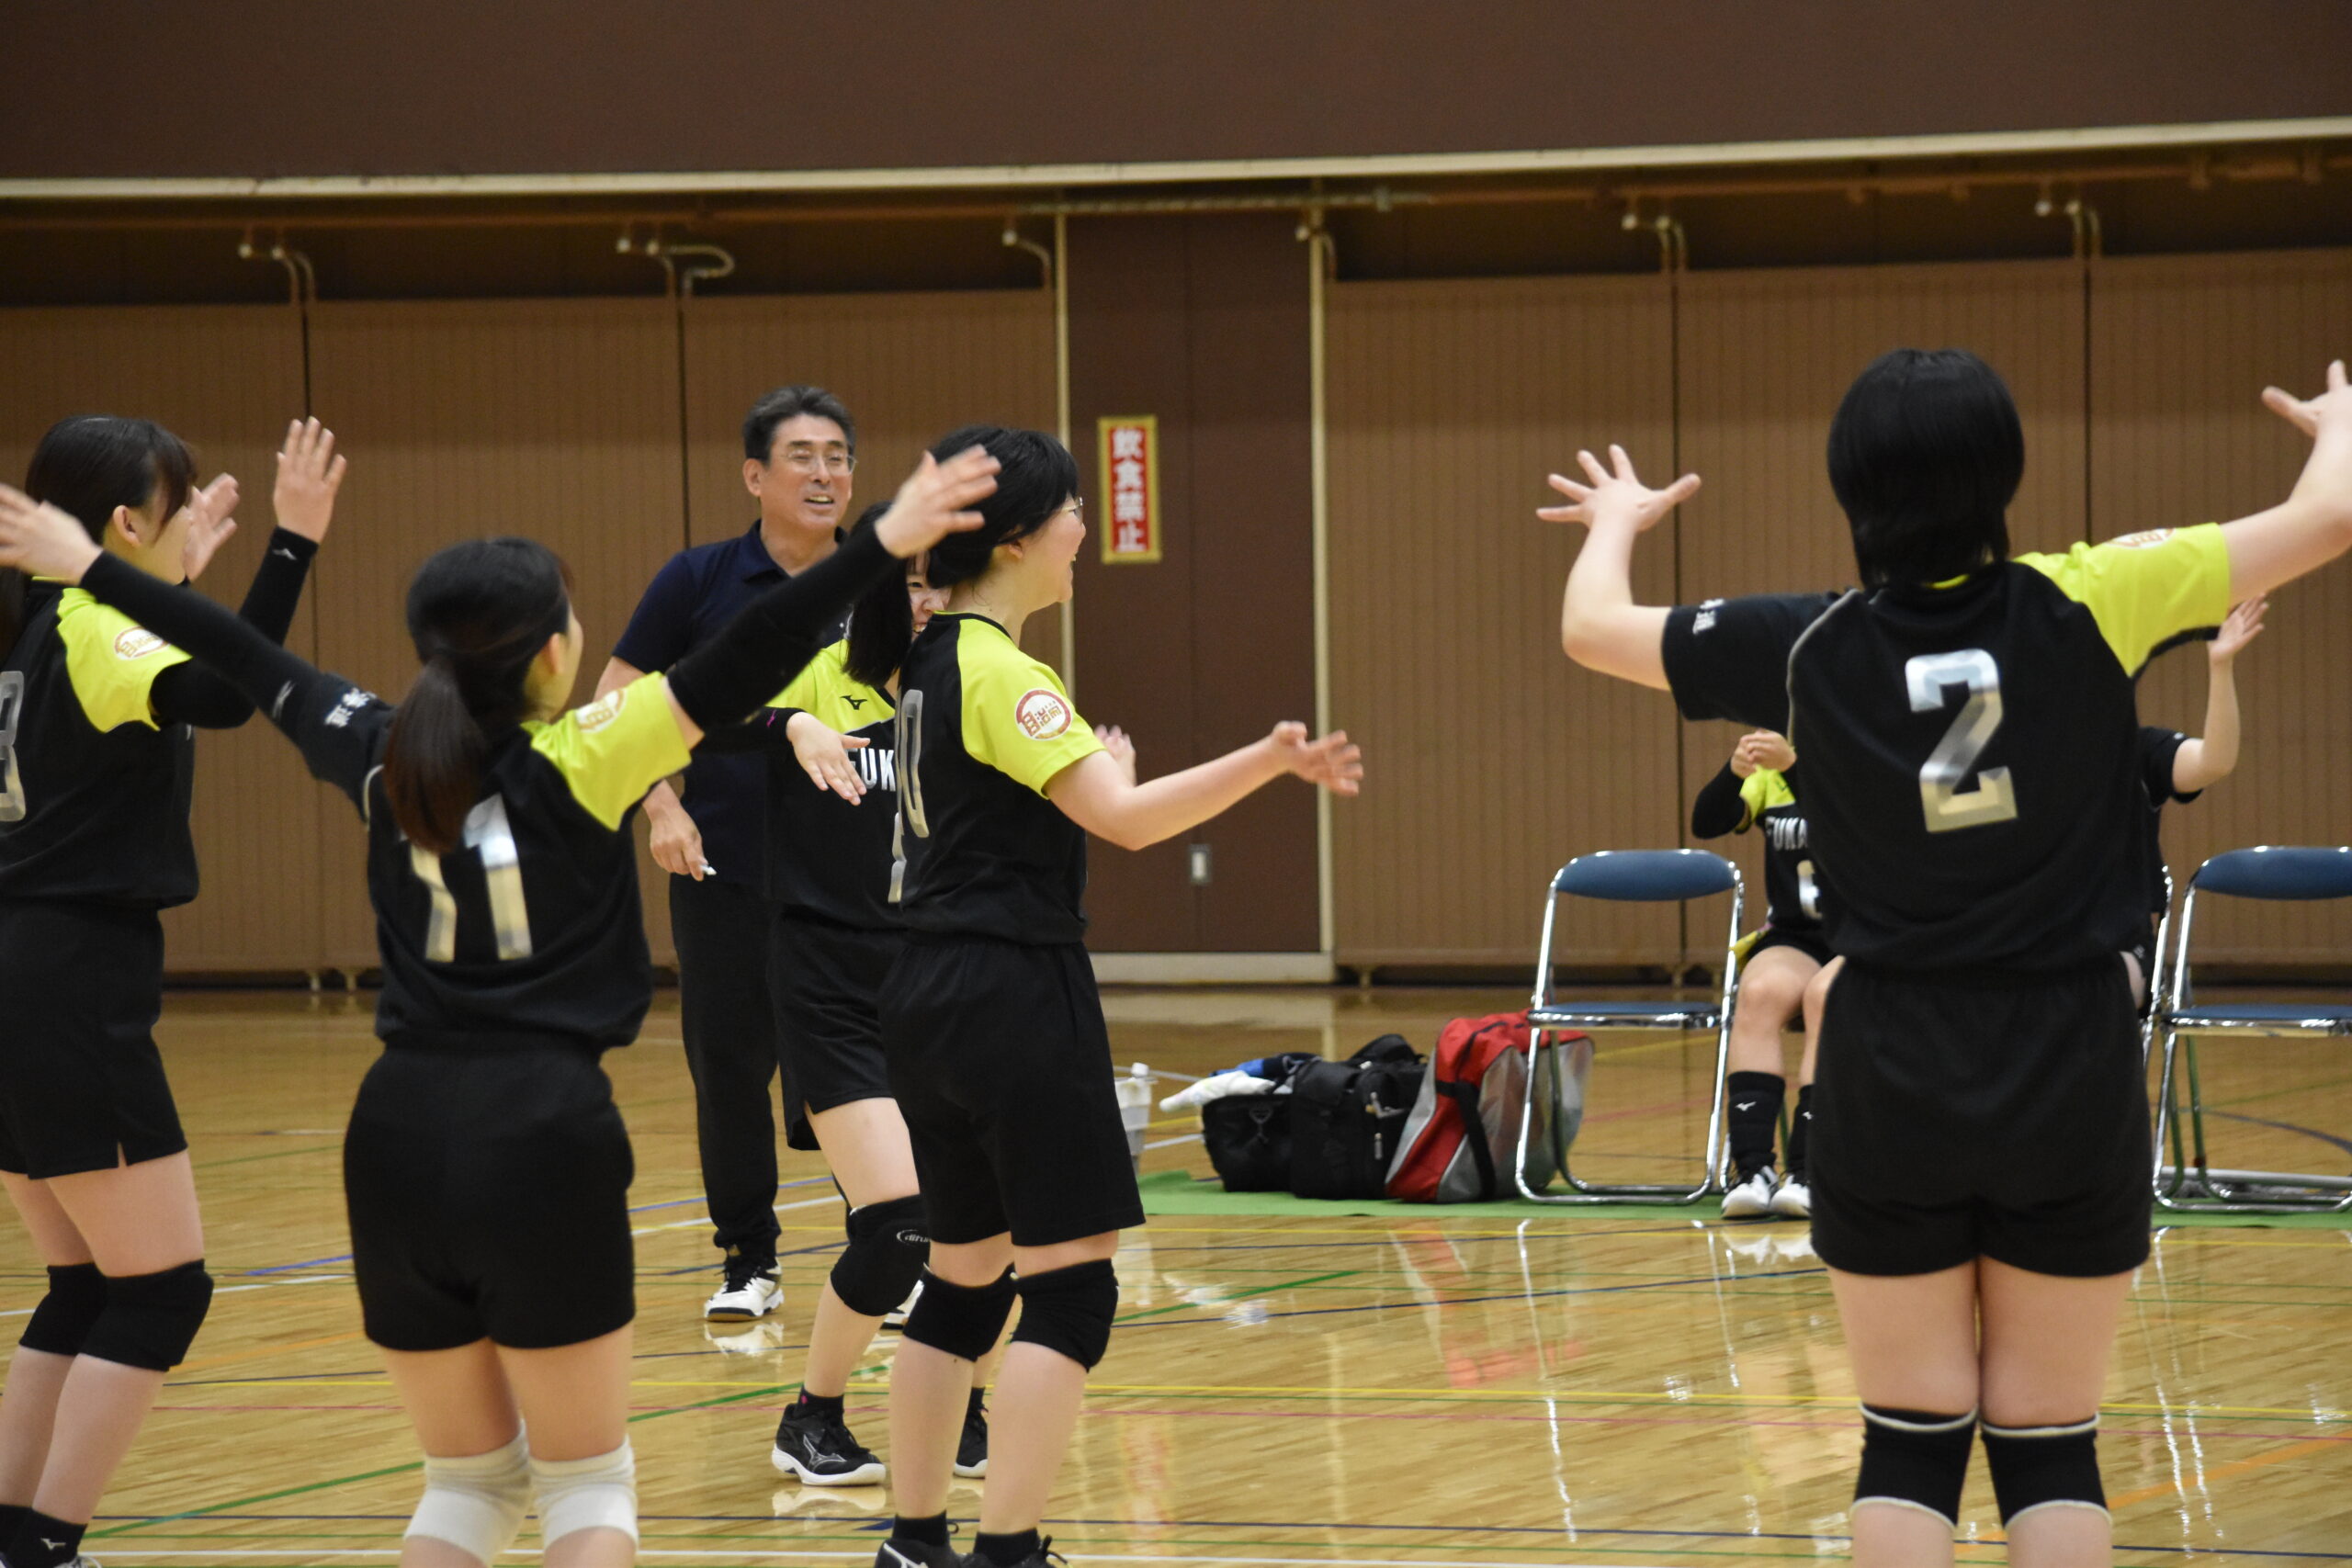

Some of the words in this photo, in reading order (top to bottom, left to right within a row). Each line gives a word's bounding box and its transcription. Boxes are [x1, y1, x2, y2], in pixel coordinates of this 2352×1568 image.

[1112, 428, 1147, 553] 飲食禁止
[1905, 649, 2018, 832] 2
